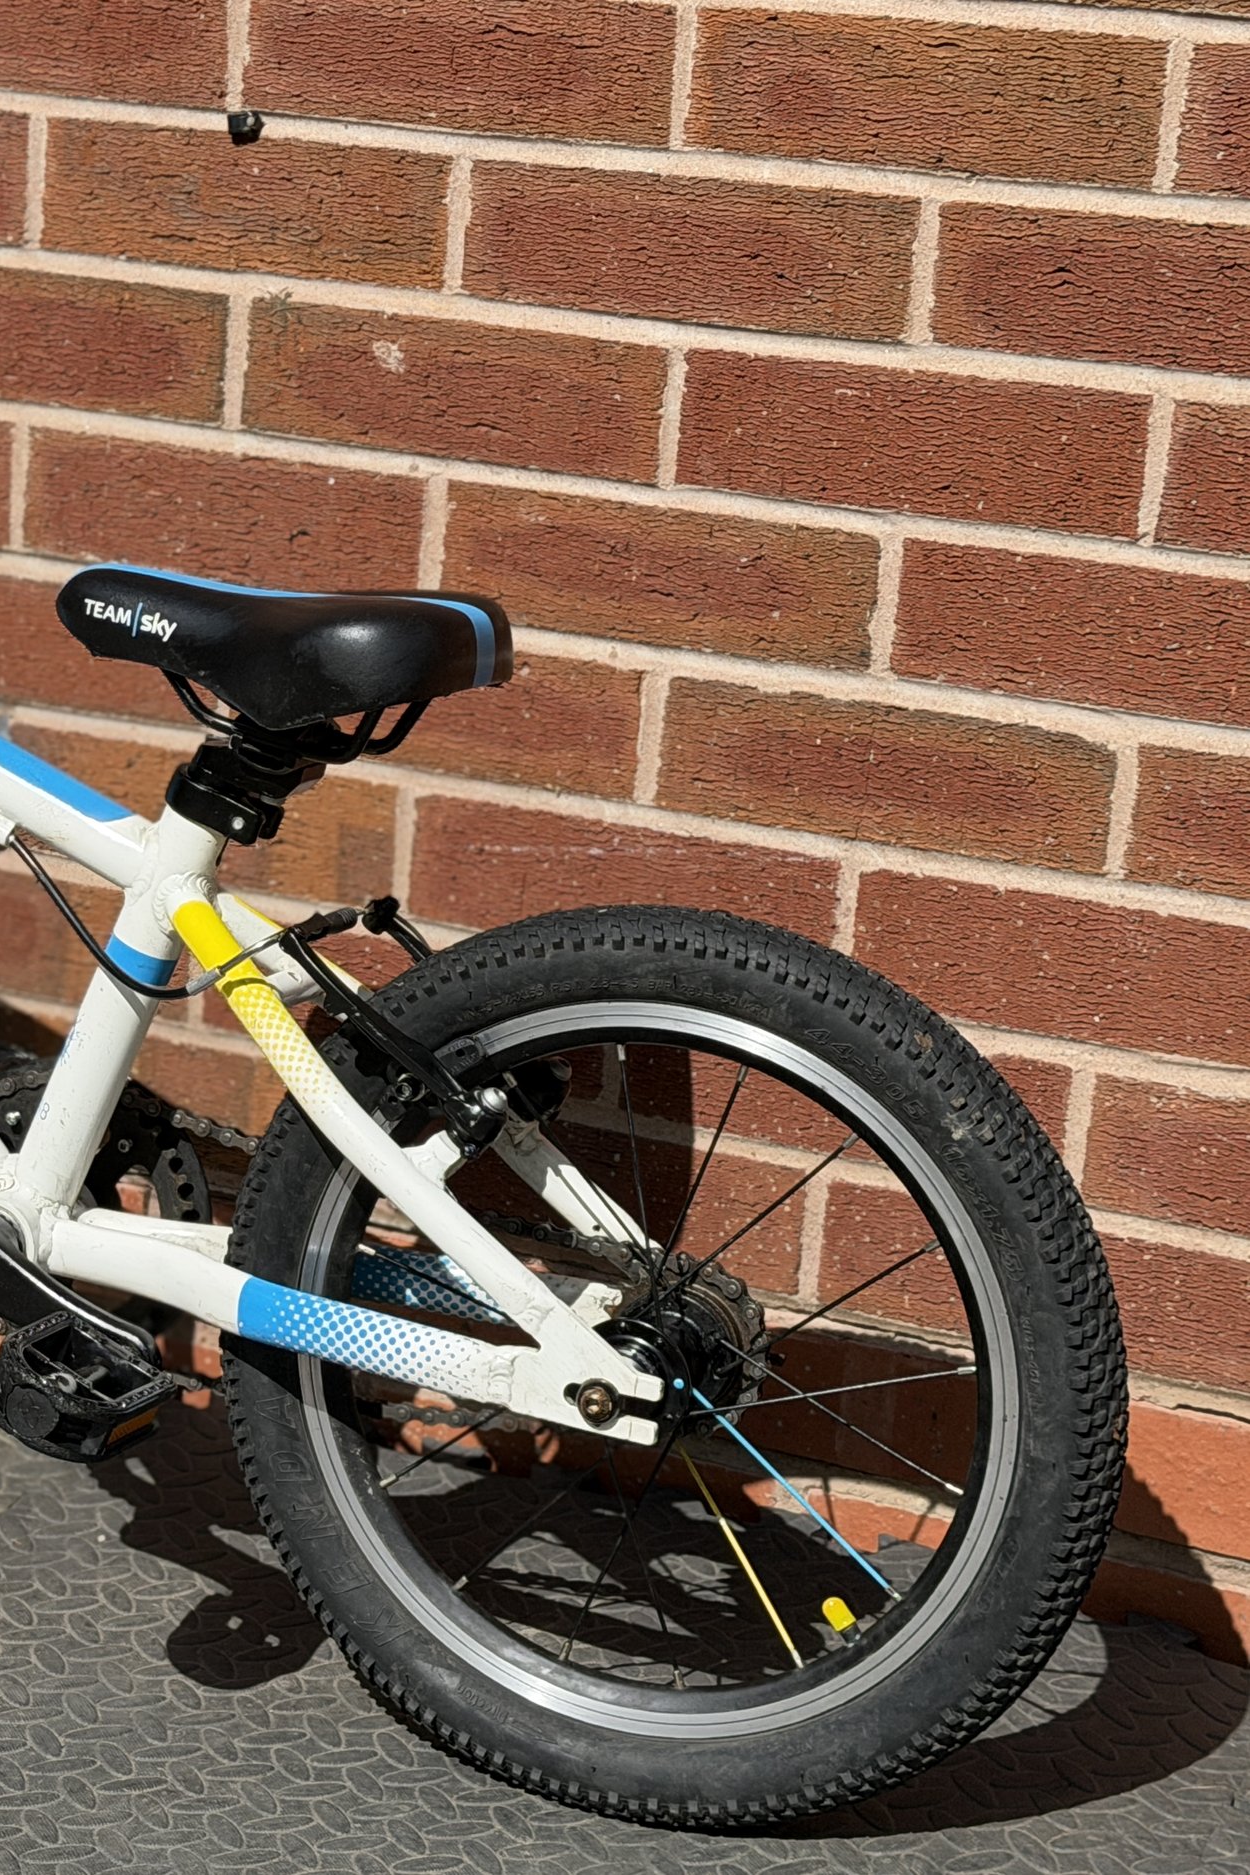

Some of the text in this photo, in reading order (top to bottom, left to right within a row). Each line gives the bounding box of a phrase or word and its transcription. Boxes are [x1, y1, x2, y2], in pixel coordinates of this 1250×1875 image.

[84, 598, 178, 642] TEAM sky
[253, 1392, 414, 1649] KENDA
